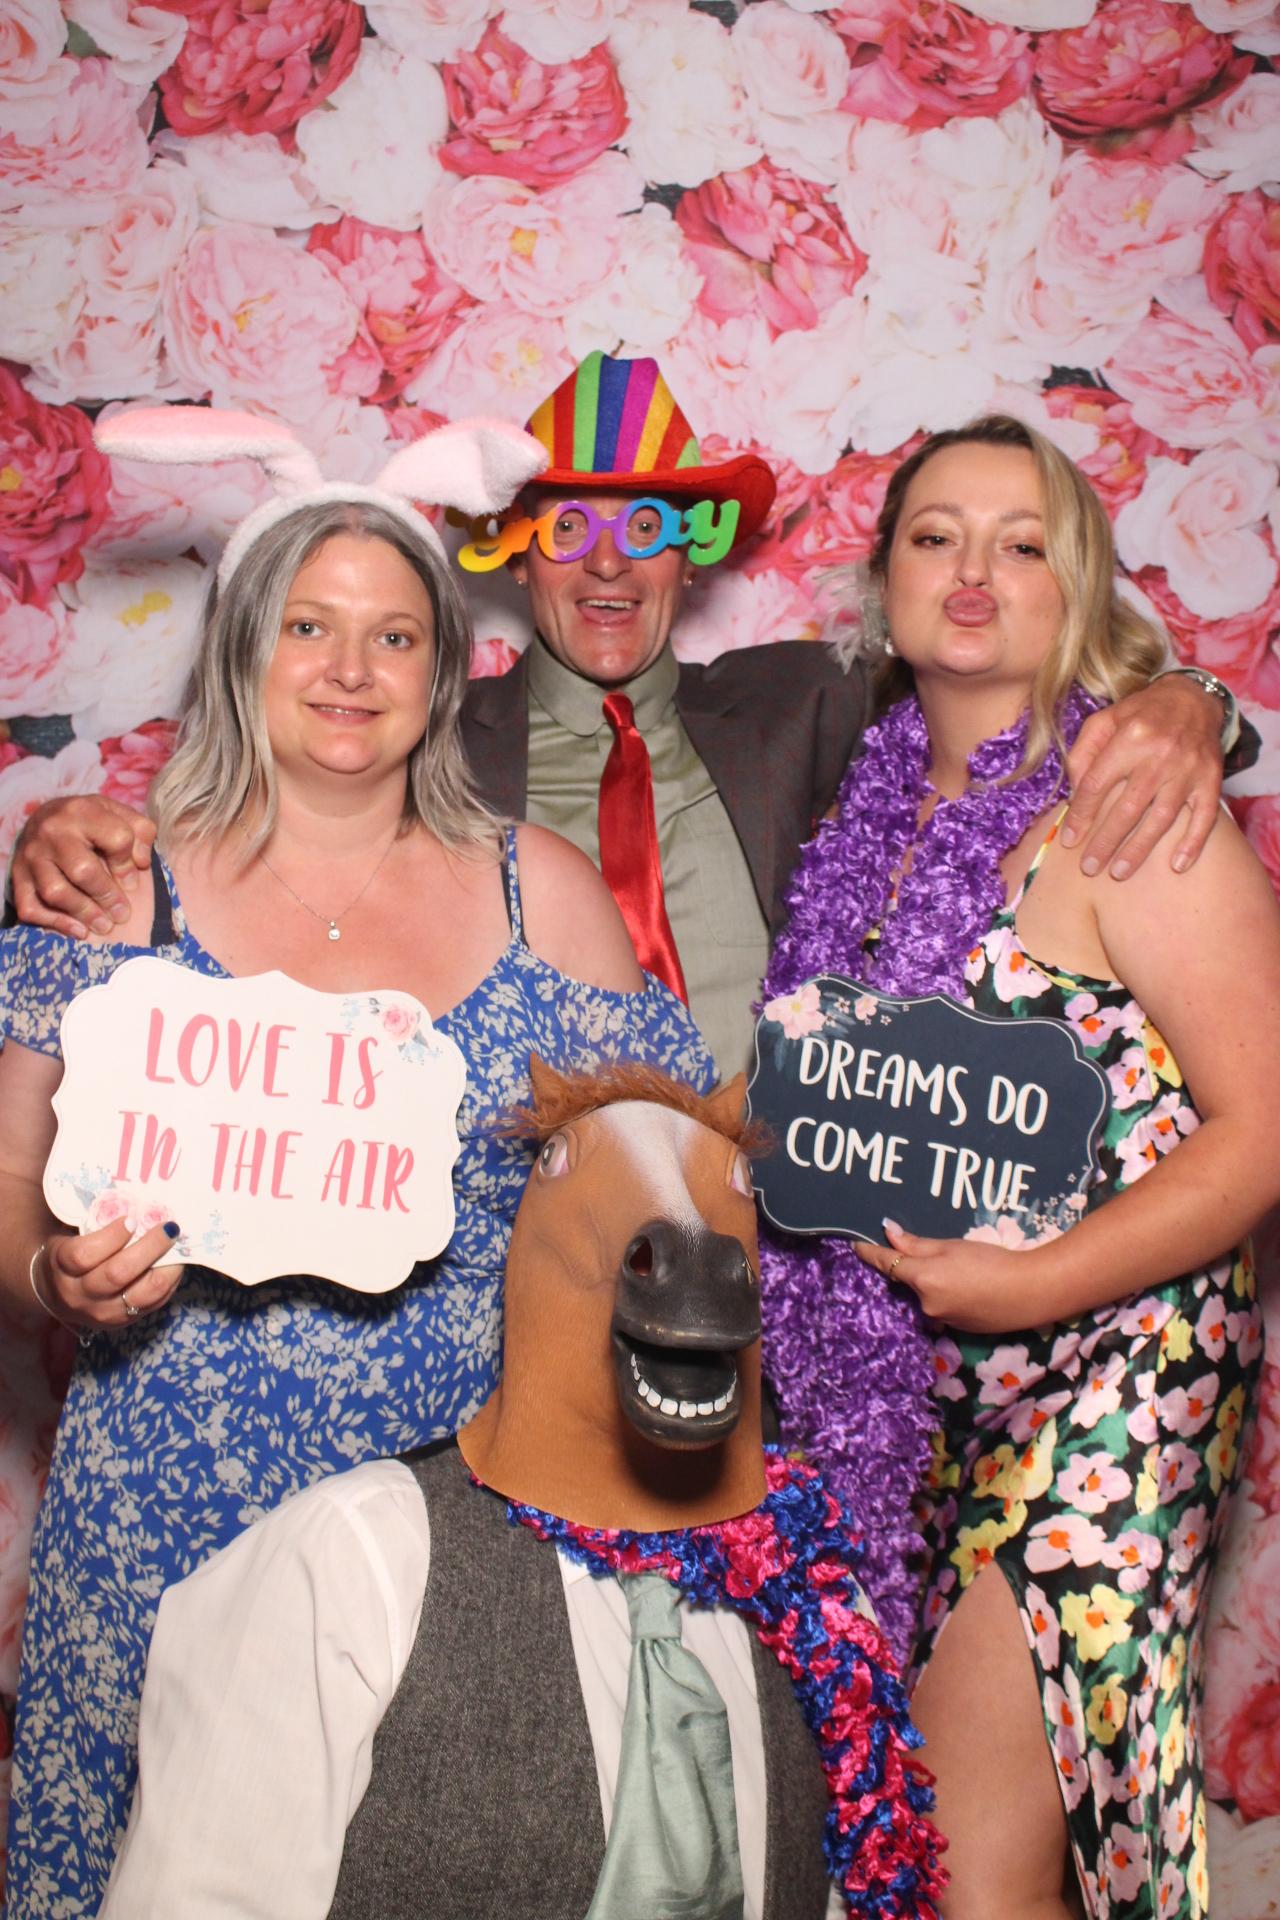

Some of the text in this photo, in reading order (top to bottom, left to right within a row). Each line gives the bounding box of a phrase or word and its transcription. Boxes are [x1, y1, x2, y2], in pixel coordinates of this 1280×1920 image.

[145, 1007, 384, 1110] LOVE IS
[799, 1037, 1049, 1135] DREAMS DO
[111, 1110, 415, 1214] IN THE AIR
[786, 1116, 1037, 1213] COME TRUE
